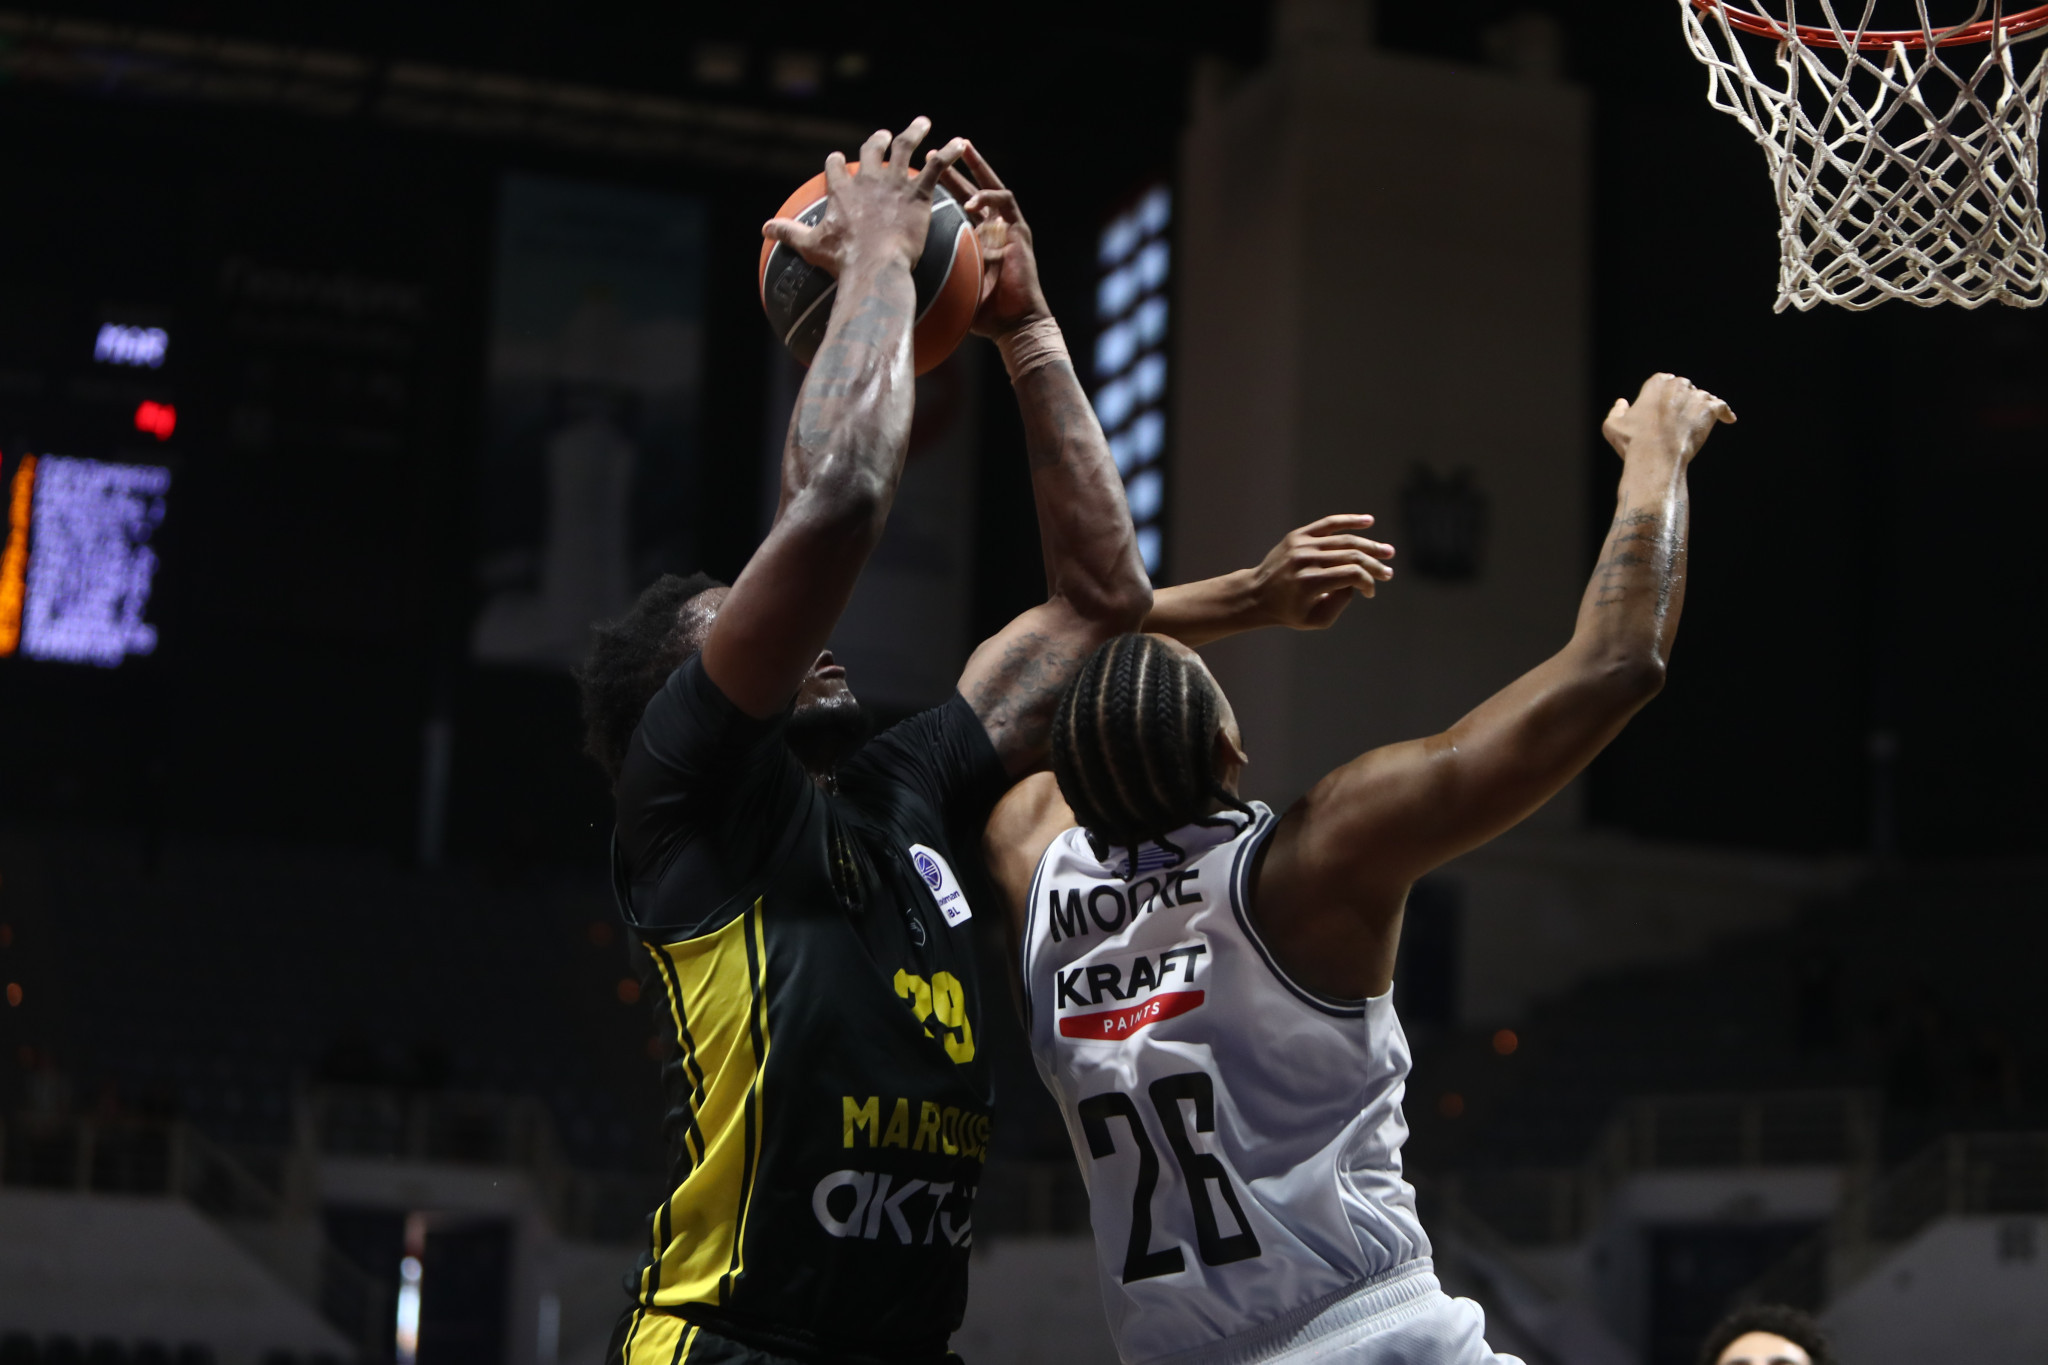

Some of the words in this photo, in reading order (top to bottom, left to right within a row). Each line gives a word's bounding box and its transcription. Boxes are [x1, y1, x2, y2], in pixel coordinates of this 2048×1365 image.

[893, 967, 976, 1064] 29
[1057, 945, 1206, 1009] KRAFT
[1103, 1001, 1161, 1034] PAINTS
[1077, 1072, 1261, 1285] 26
